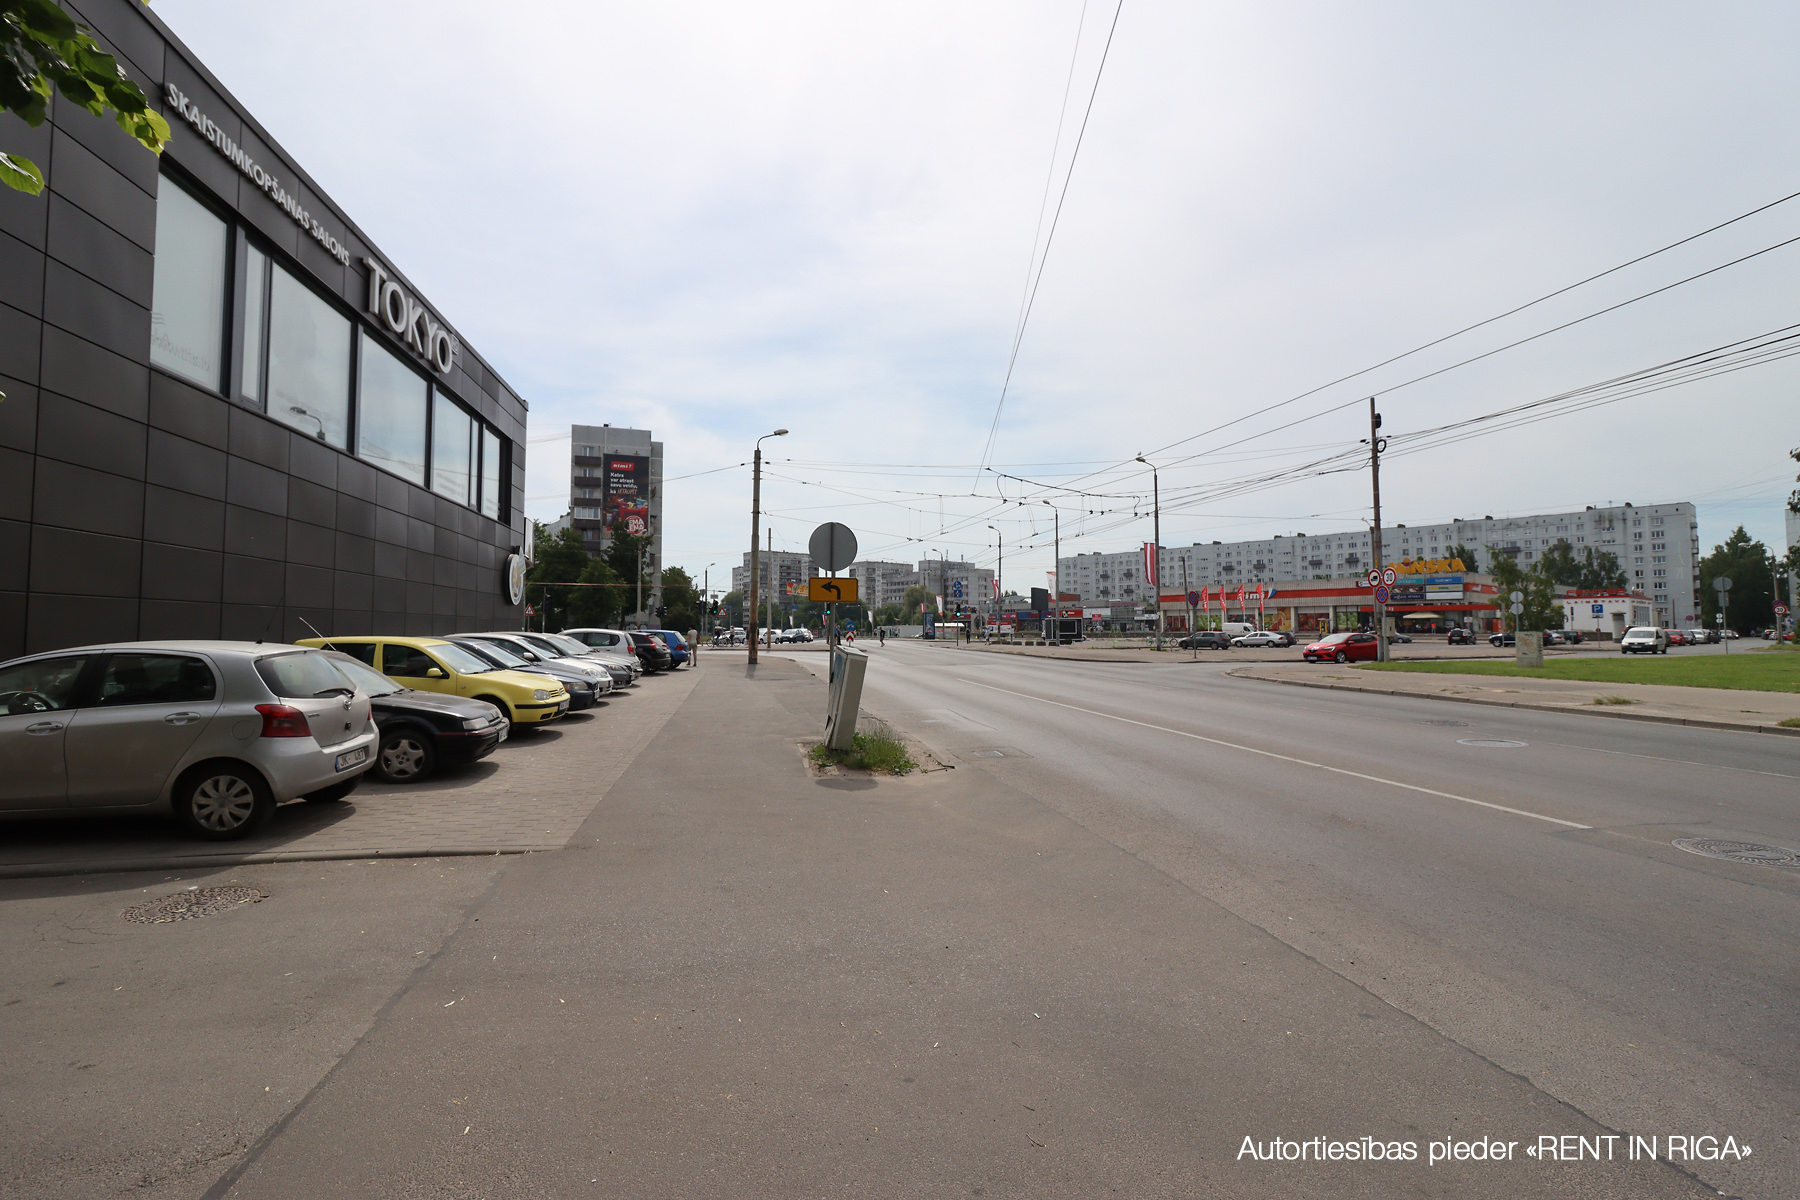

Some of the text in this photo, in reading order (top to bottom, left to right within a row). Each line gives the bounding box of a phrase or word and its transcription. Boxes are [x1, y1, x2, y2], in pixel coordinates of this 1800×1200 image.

[166, 83, 350, 267] SKAISTUMKOPŠANAS SALONS
[363, 257, 453, 373] TOKYO
[1386, 572, 1393, 582] 30
